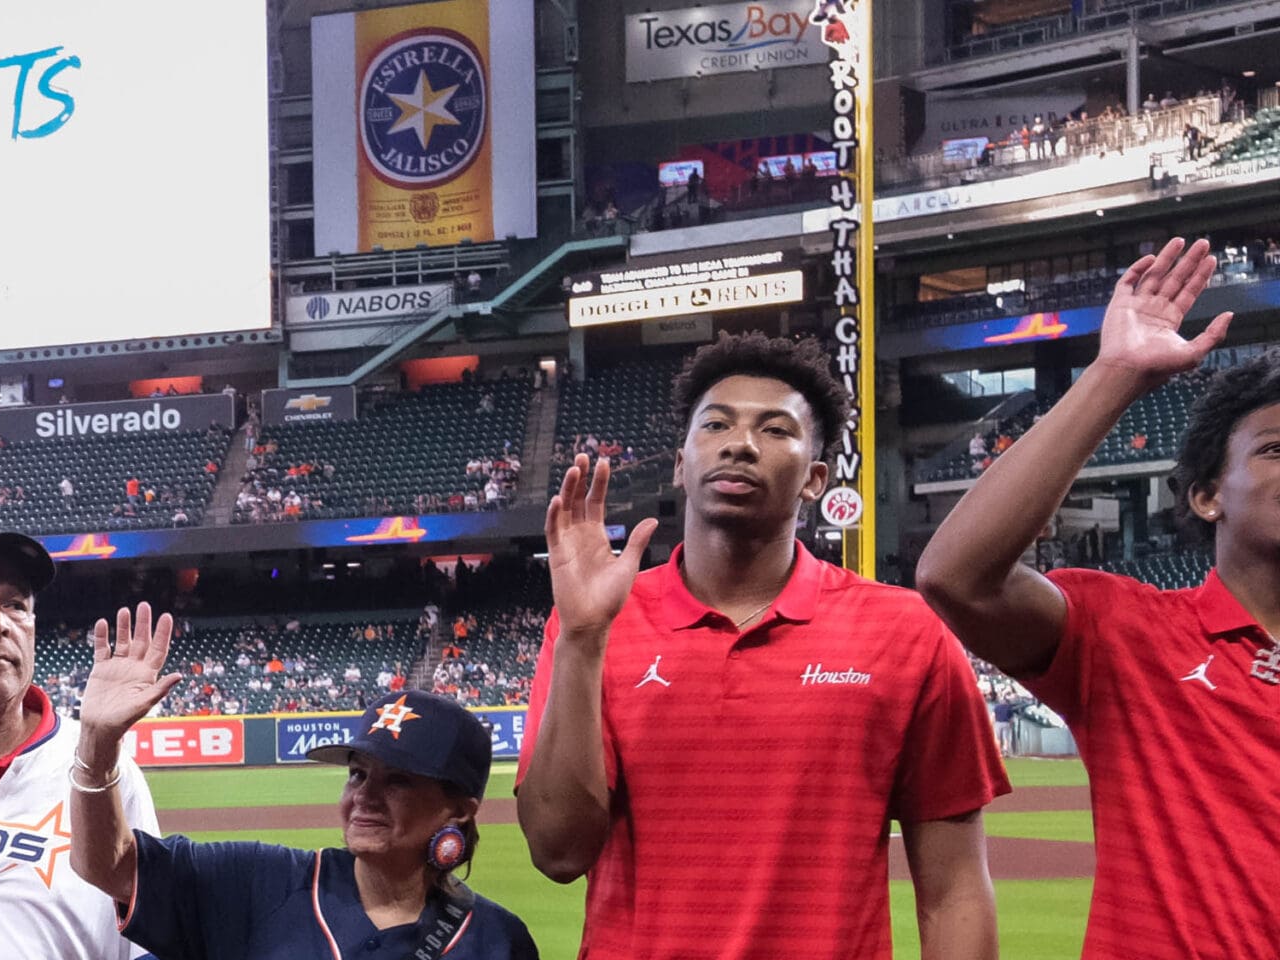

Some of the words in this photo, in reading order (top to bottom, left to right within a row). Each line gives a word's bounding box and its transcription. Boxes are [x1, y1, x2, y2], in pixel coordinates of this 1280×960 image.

[639, 17, 732, 50] Texas
[746, 5, 809, 46] Bay
[372, 46, 476, 94] ESTRELLA
[701, 53, 750, 69] CREDIT
[756, 48, 809, 64] UNION
[830, 60, 857, 168] ROOT
[381, 138, 470, 174] JALISCO
[831, 180, 853, 209] 4
[832, 221, 857, 306] THA
[337, 291, 433, 316] NABORS
[718, 280, 787, 303] RENTS
[35, 403, 181, 438] Silverado
[800, 663, 872, 686] Houston
[287, 723, 340, 732] HOUSTON
[371, 703, 414, 732] H
[287, 727, 354, 756] Meth
